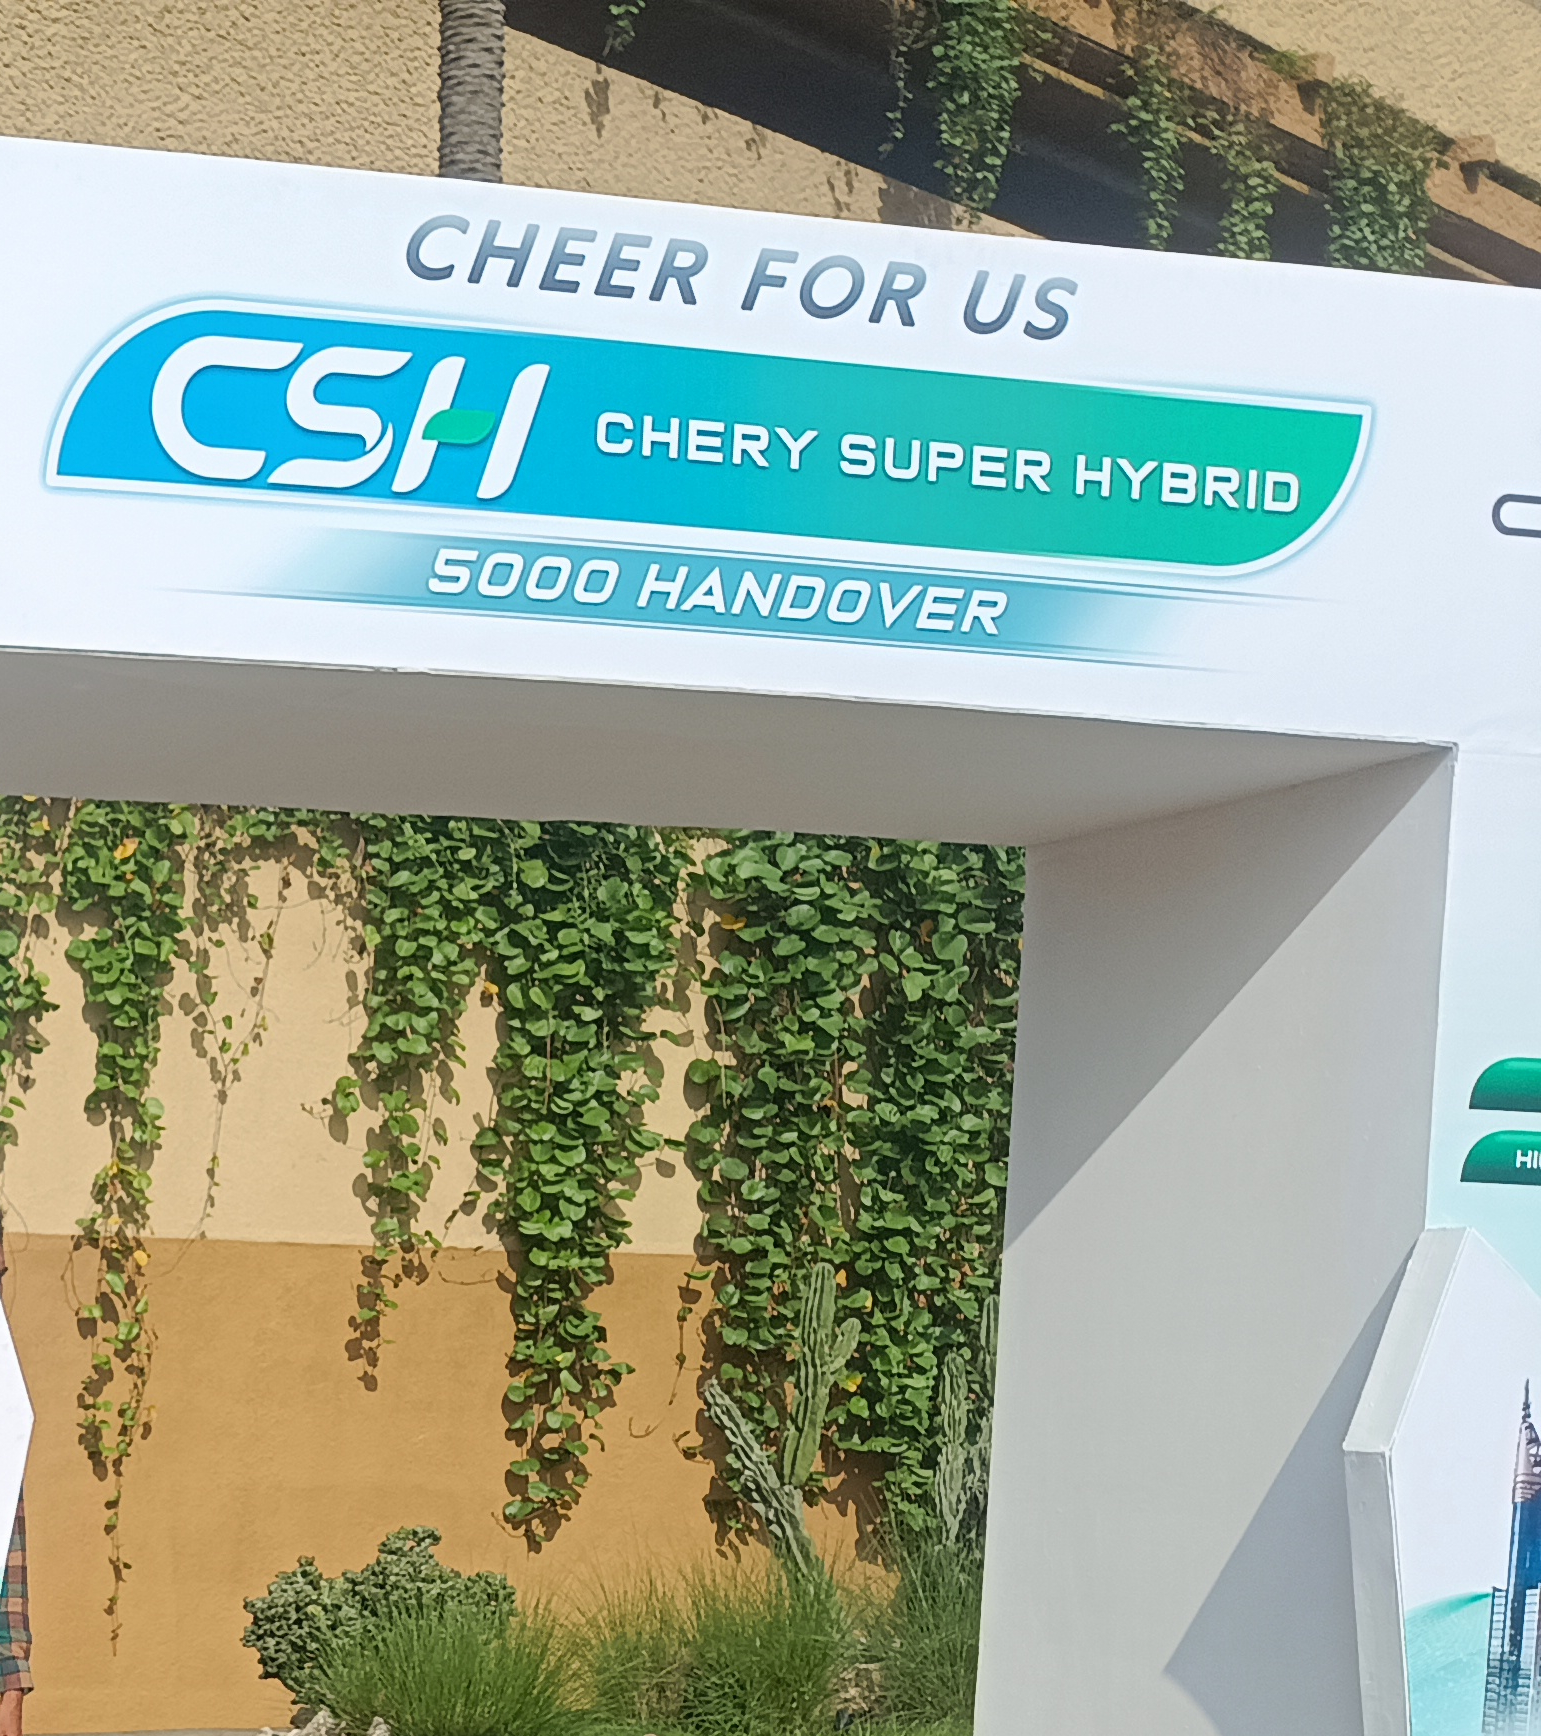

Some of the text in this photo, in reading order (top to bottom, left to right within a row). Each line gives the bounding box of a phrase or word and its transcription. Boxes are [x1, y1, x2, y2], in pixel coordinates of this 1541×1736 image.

[405, 214, 1079, 341] CHEER FOR US
[150, 334, 551, 500] CSH
[595, 411, 1301, 514] CHERY SUPER HYBRID
[426, 547, 1009, 636] 5000 HANDOVER
[1516, 1149, 1541, 1170] HI
